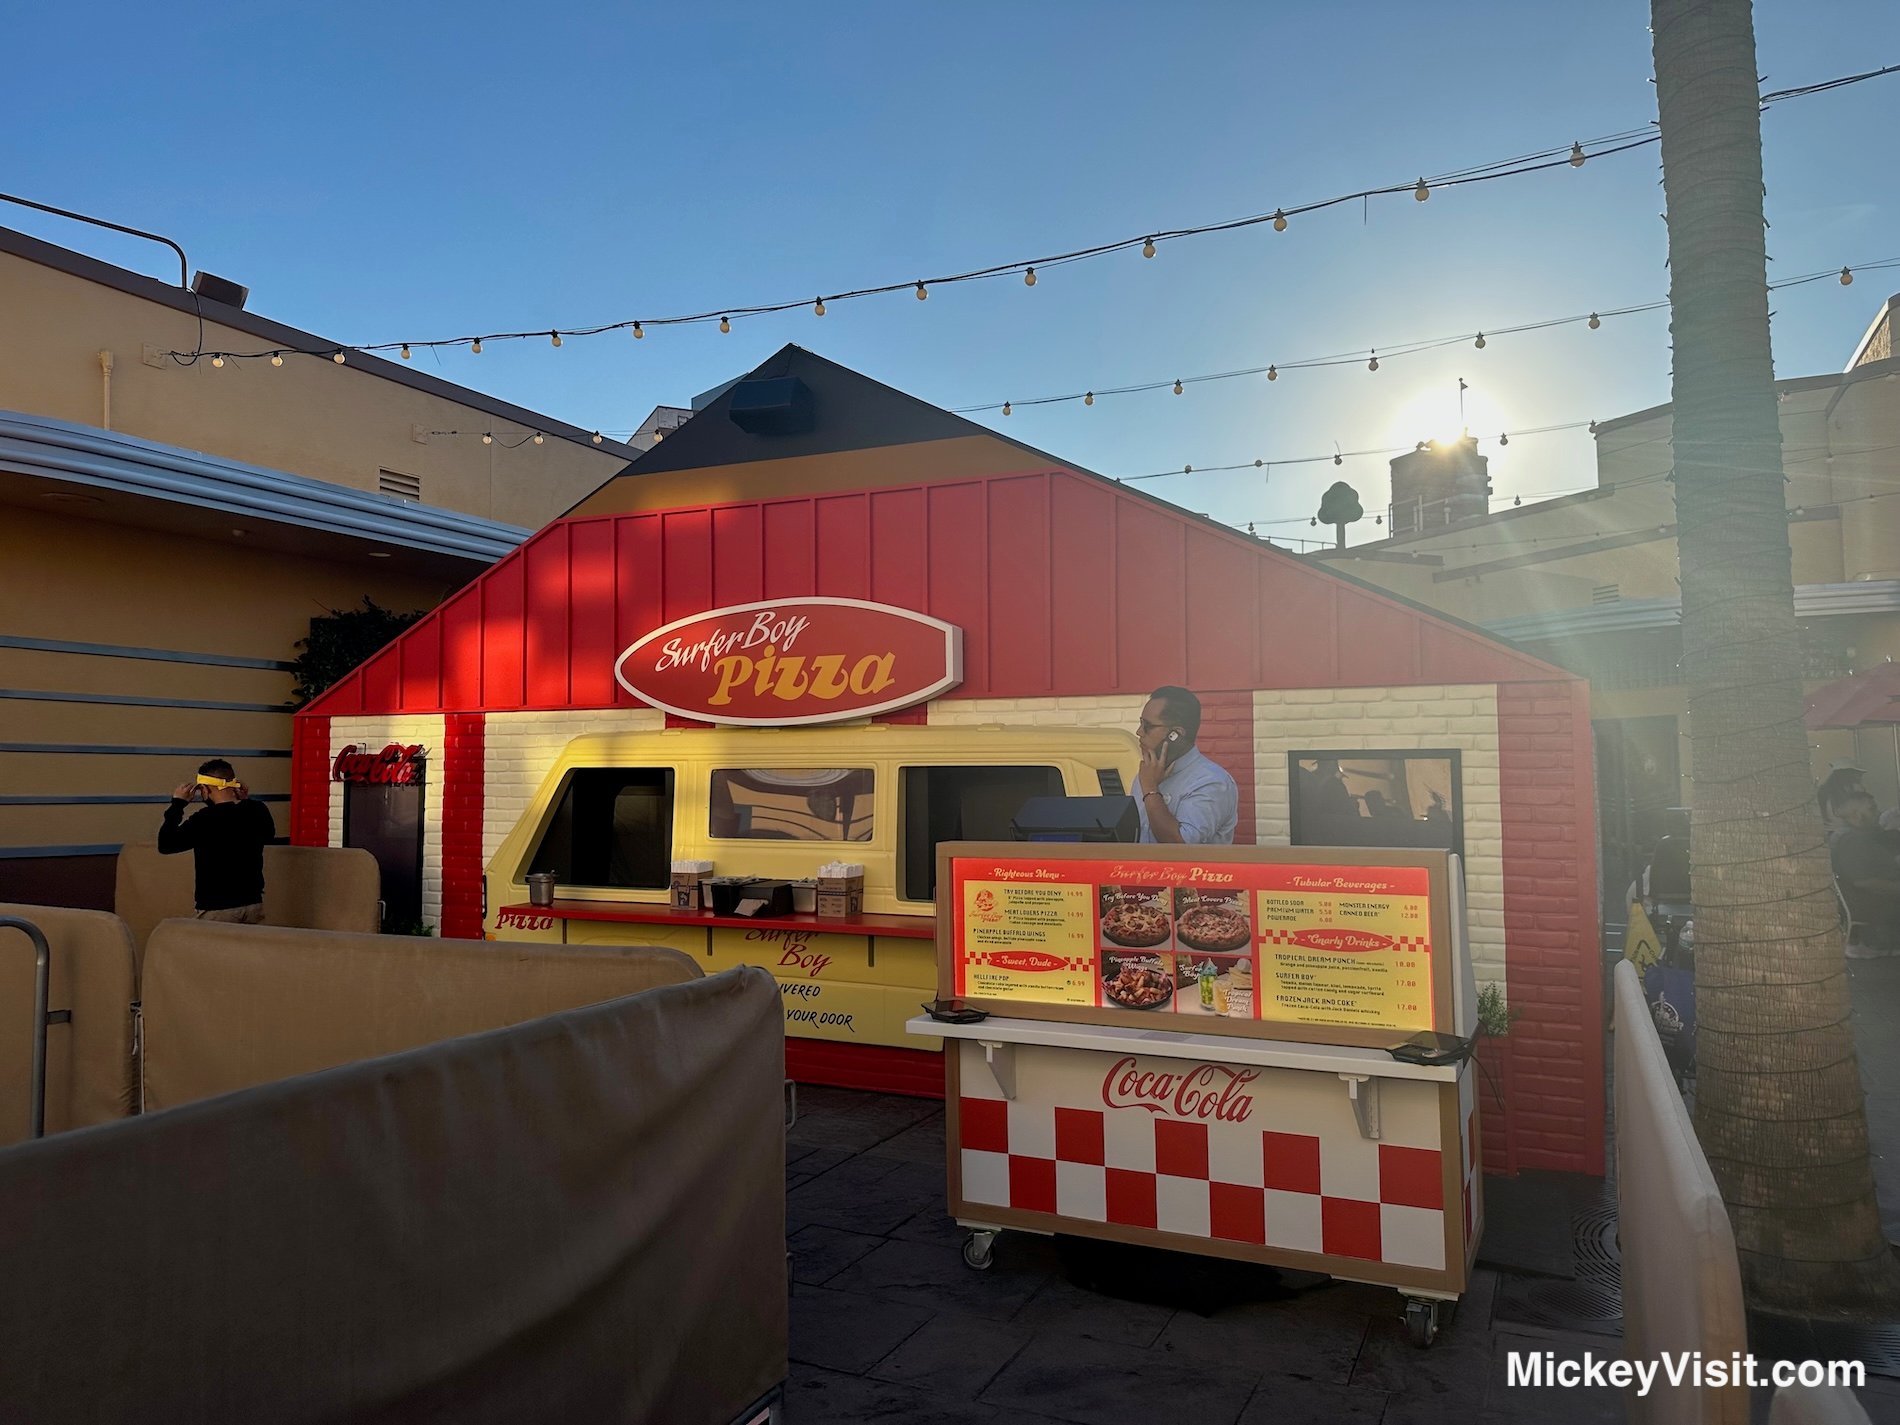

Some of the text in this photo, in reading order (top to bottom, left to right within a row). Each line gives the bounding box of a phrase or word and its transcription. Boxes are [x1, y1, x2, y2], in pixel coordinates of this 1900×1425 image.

[655, 611, 811, 673] Surfer Boy
[708, 645, 897, 706] Pizza
[994, 867, 1060, 880] Righteous Menu
[1110, 864, 1234, 885] Surfer Boy Pizza
[1293, 876, 1388, 893] Tubular Beverages
[1103, 894, 1115, 902] Try
[1114, 892, 1136, 900] Before
[1136, 892, 1150, 902] You
[494, 913, 553, 930] Pizza
[1307, 934, 1380, 948] Gnarly Drinks
[777, 943, 833, 977] Boy
[1001, 955, 1052, 967] Sweet, Dude
[779, 983, 821, 1001] IVERED
[787, 1009, 855, 1033] YOUR DOOR
[1102, 1057, 1262, 1123] Coca-Cola
